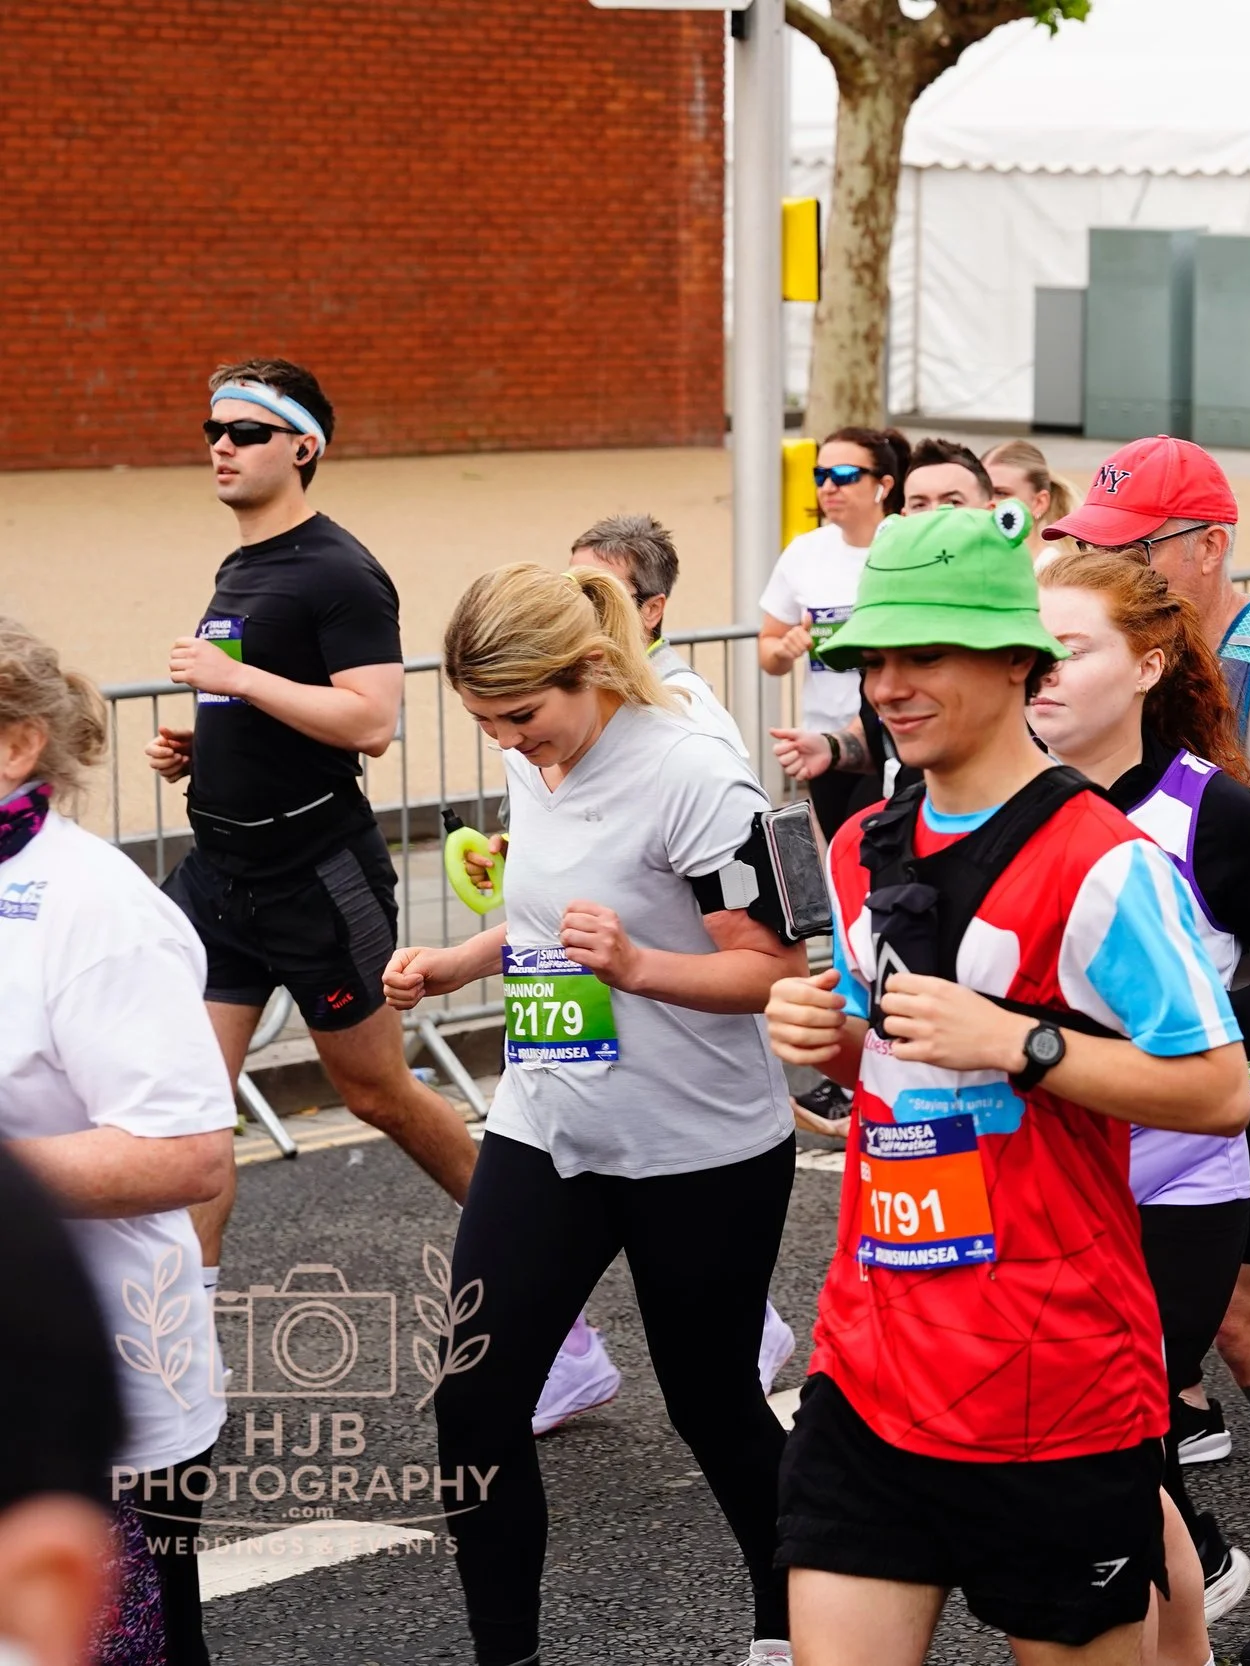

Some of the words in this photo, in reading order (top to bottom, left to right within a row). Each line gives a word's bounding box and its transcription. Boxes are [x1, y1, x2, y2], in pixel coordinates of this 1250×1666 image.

[1093, 464, 1130, 493] NY
[512, 1000, 584, 1036] 2179
[878, 1124, 935, 1140] SWANSEA
[870, 1188, 946, 1237] 1791
